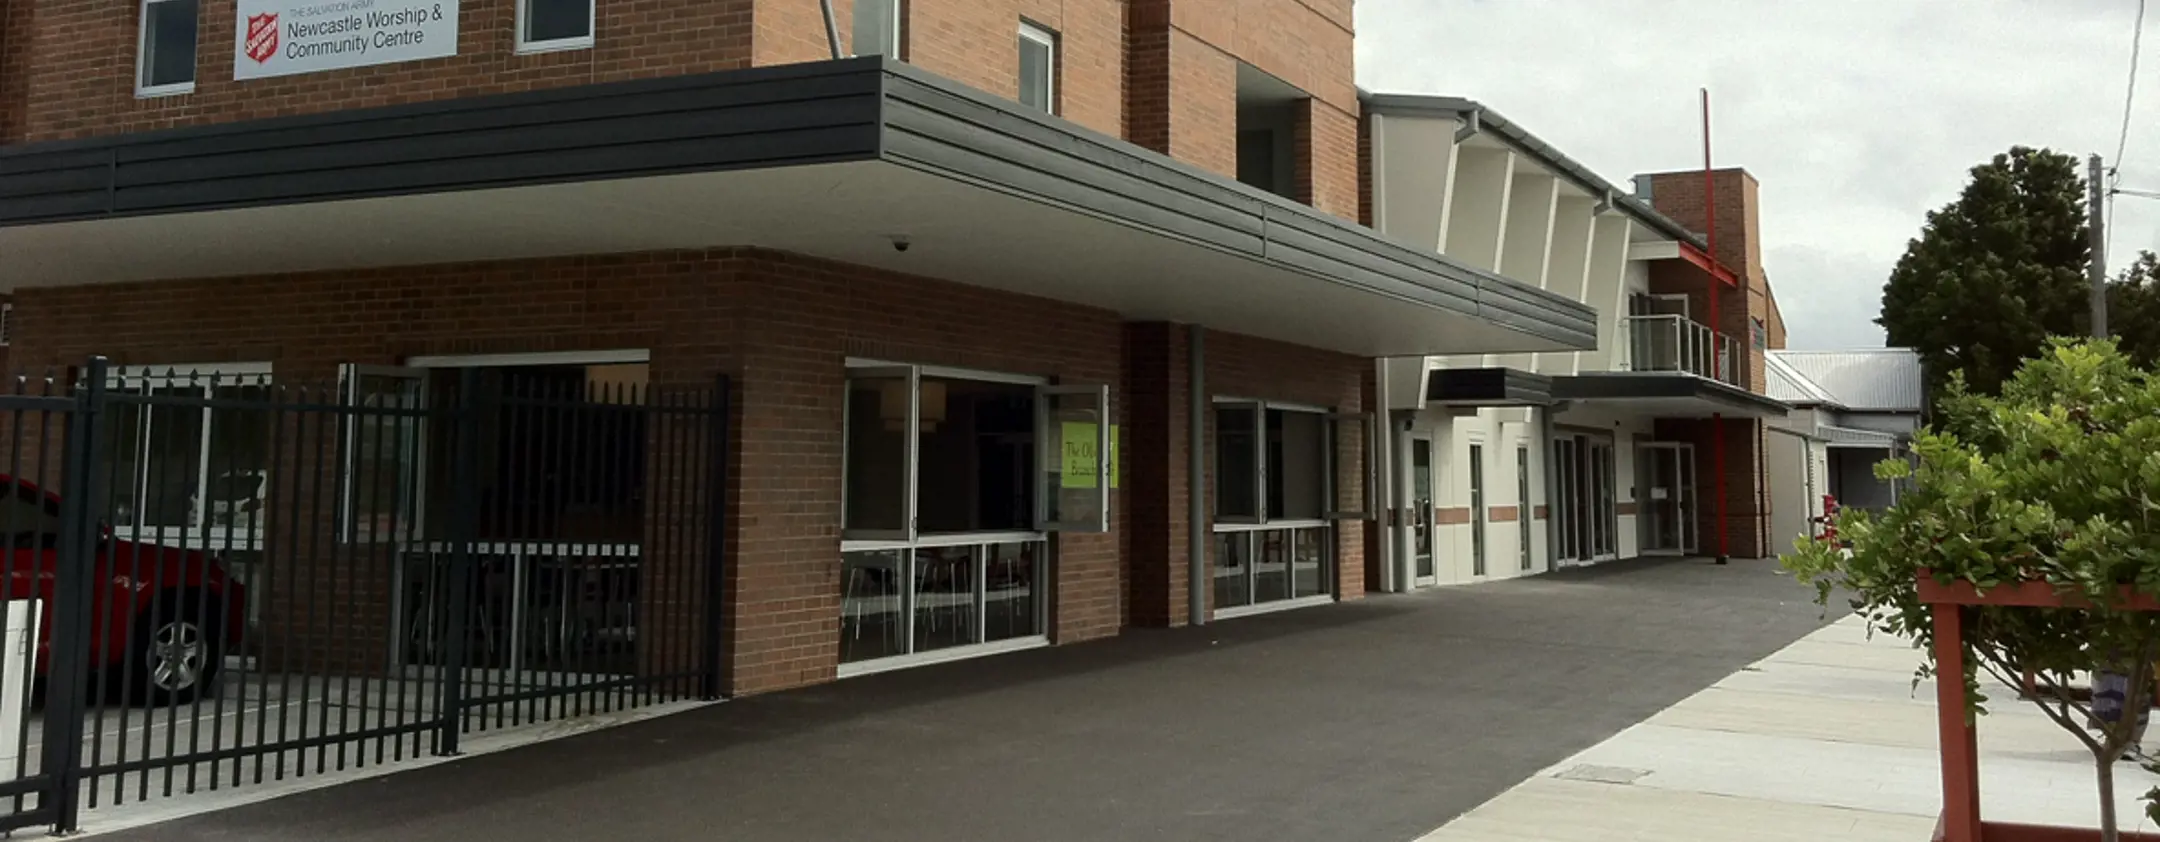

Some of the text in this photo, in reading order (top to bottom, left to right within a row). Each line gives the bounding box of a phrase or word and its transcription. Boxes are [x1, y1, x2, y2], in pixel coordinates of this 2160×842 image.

[287, 3, 443, 38] Newcastle Worship &
[290, 7, 306, 17] THE
[286, 29, 424, 60] Community Centre
[1066, 441, 1080, 457] The
